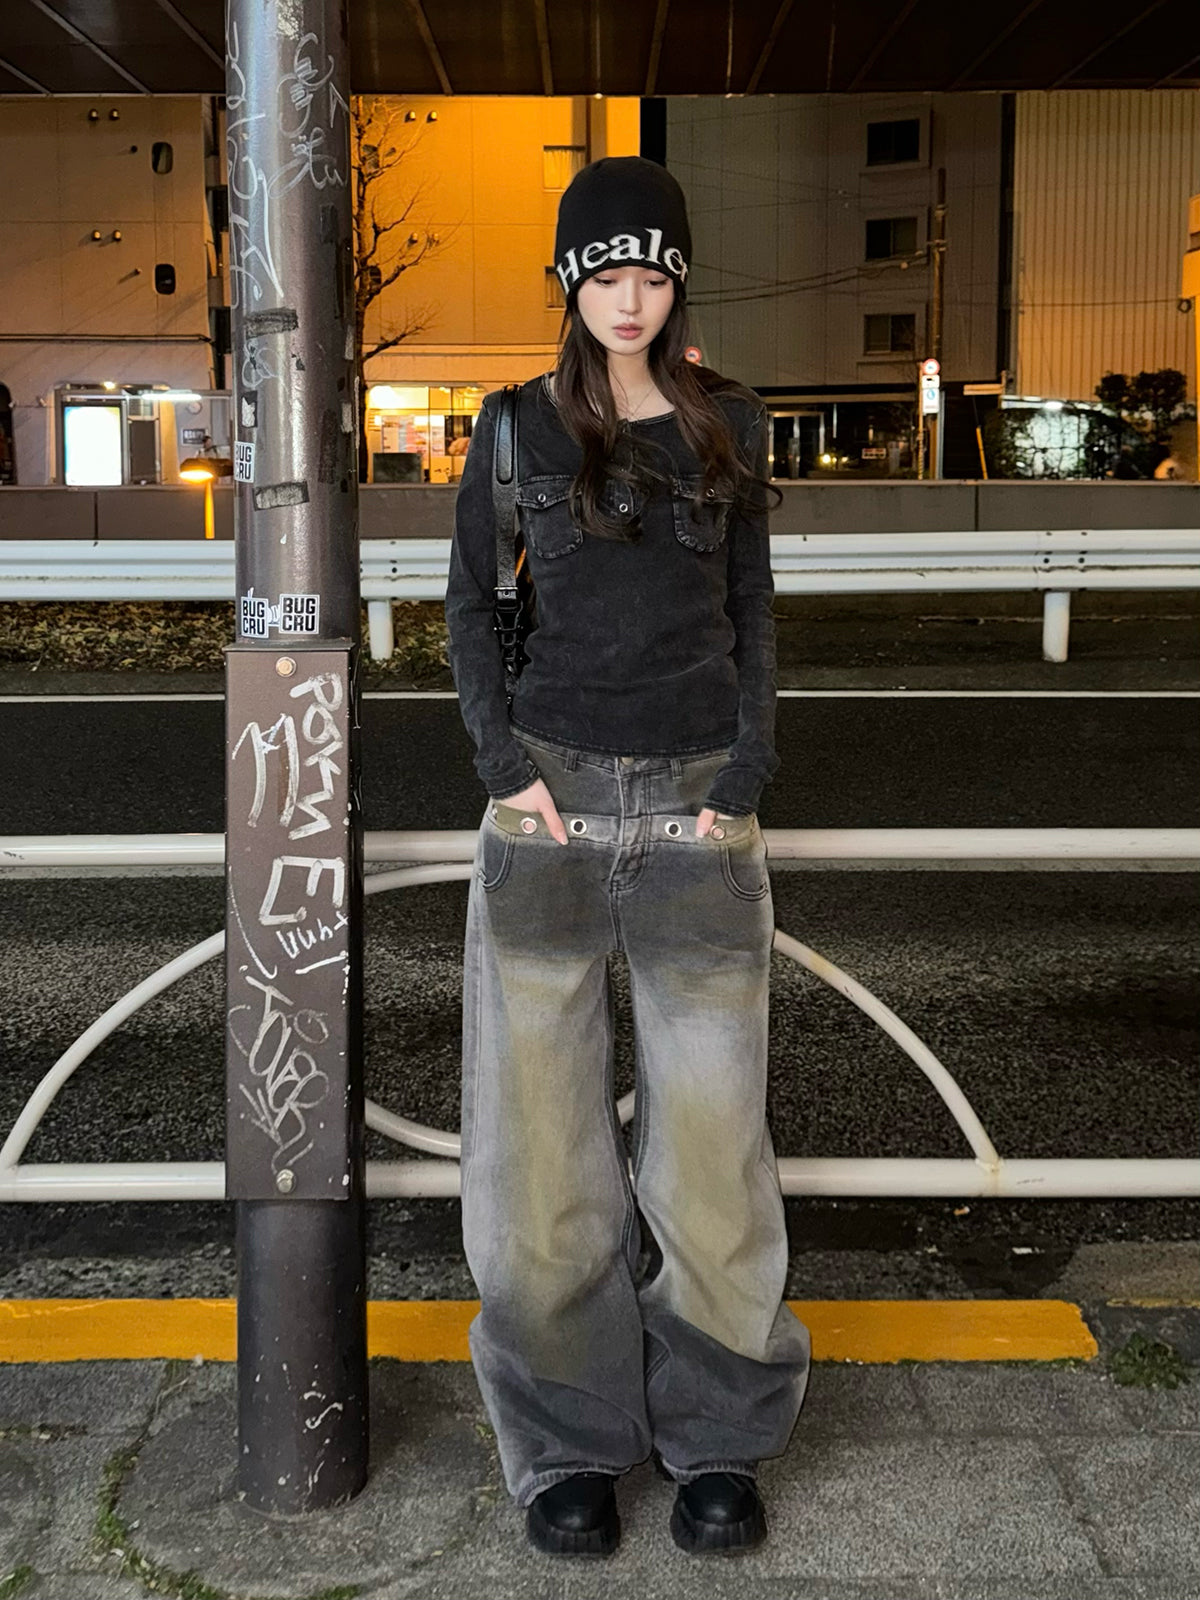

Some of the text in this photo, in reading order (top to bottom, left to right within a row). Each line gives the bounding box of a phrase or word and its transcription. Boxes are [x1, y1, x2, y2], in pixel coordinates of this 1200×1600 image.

[242, 600, 265, 618] BUG
[283, 597, 316, 614] BUG
[242, 617, 265, 635] CRU
[282, 614, 315, 632] CRU
